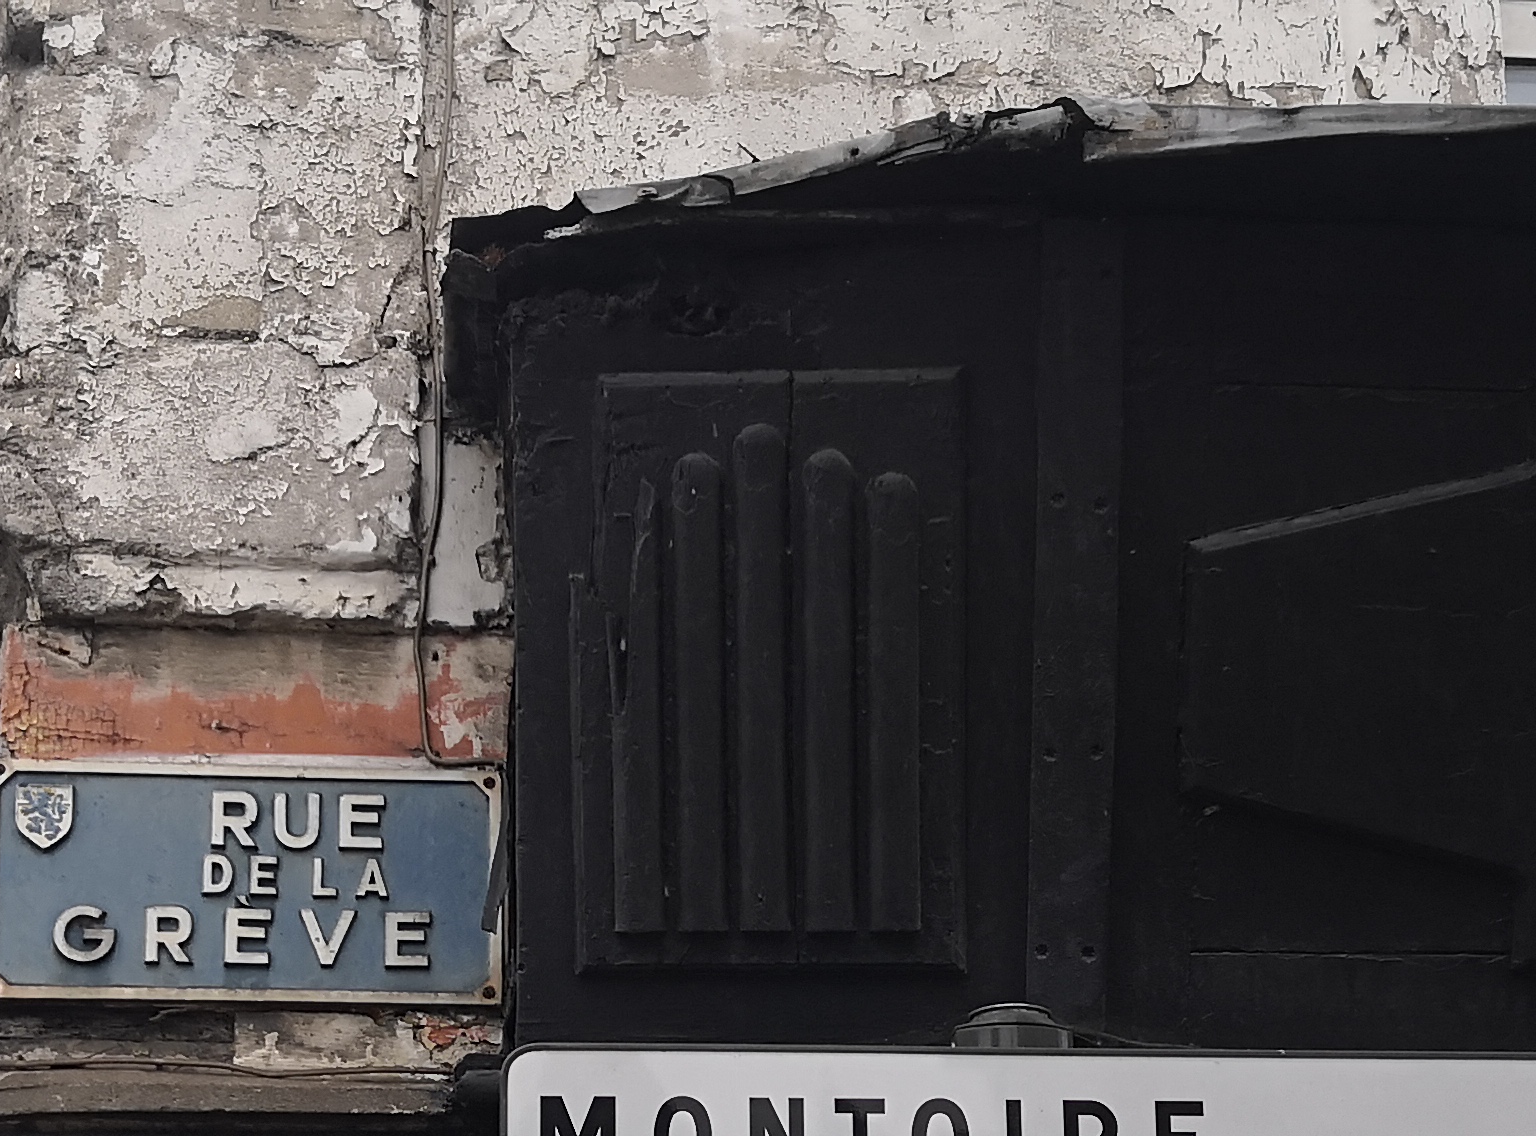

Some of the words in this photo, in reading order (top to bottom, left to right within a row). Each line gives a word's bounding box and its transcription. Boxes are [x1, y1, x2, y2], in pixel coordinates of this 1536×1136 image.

[210, 790, 385, 850] RUE
[202, 853, 277, 896] DE
[312, 857, 388, 898] LA
[52, 894, 430, 968] GRÈVE
